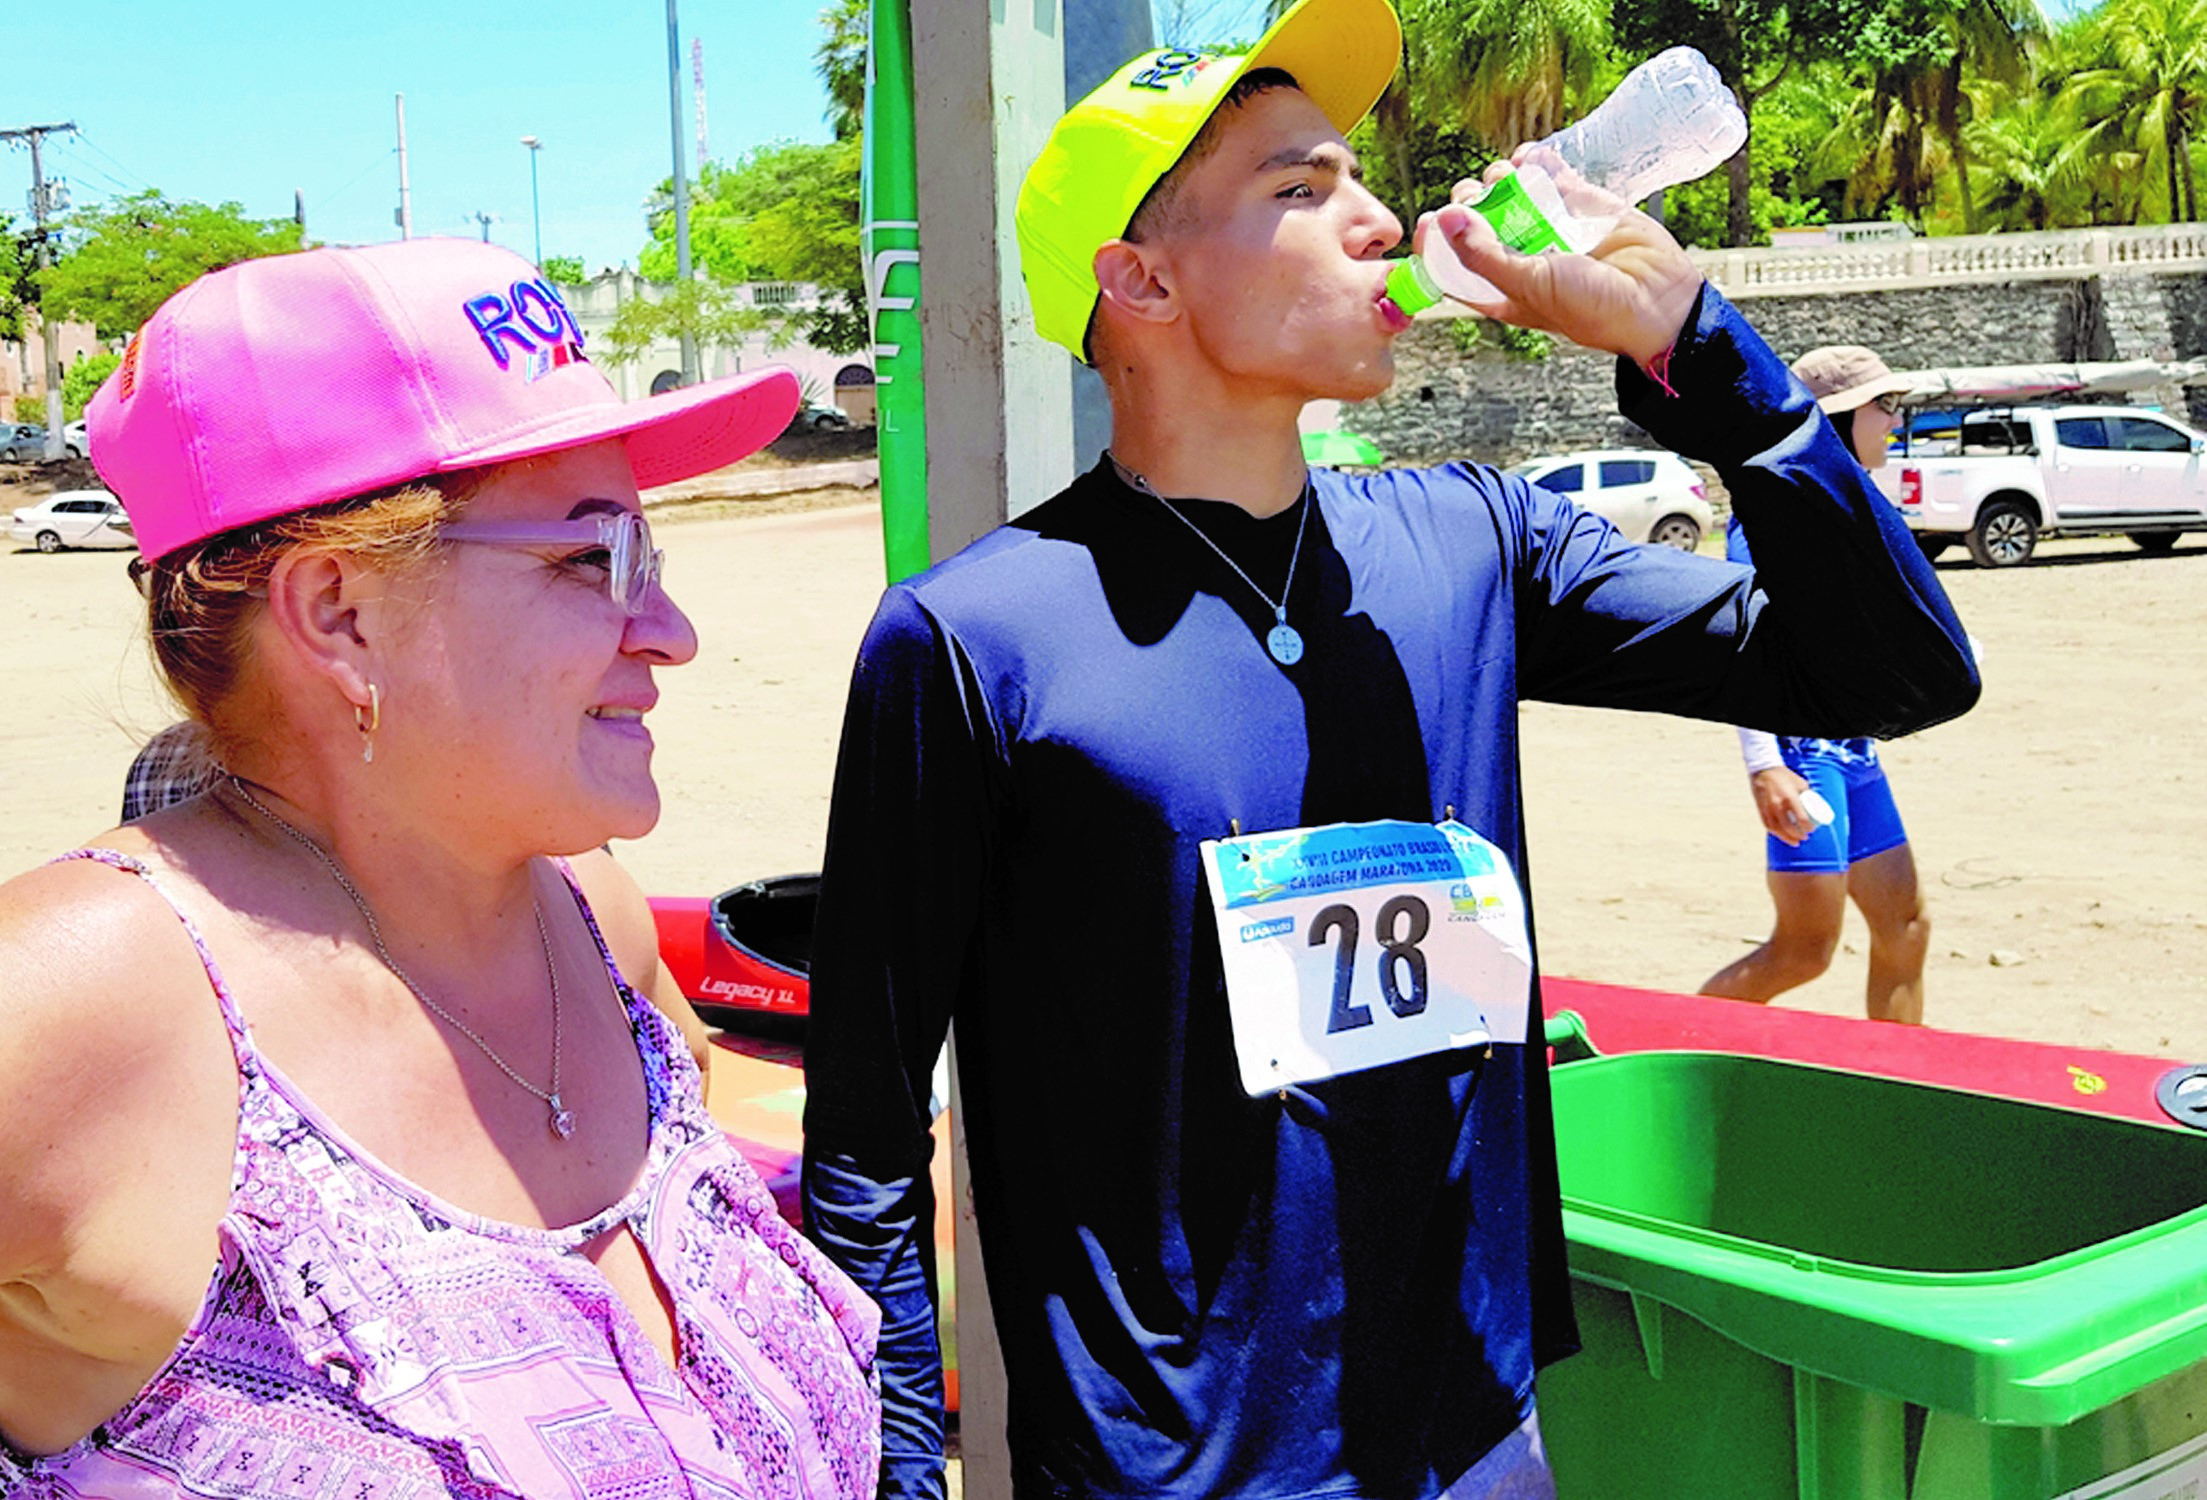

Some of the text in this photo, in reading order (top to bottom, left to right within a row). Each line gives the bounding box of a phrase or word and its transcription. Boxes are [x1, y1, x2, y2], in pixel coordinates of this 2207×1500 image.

[1331, 843, 1403, 864] CAMPEONATO
[1360, 861, 1424, 880] MARATONA
[1424, 858, 1453, 873] 2020
[1308, 895, 1431, 1035] 28
[700, 975, 774, 1006] Legacy
